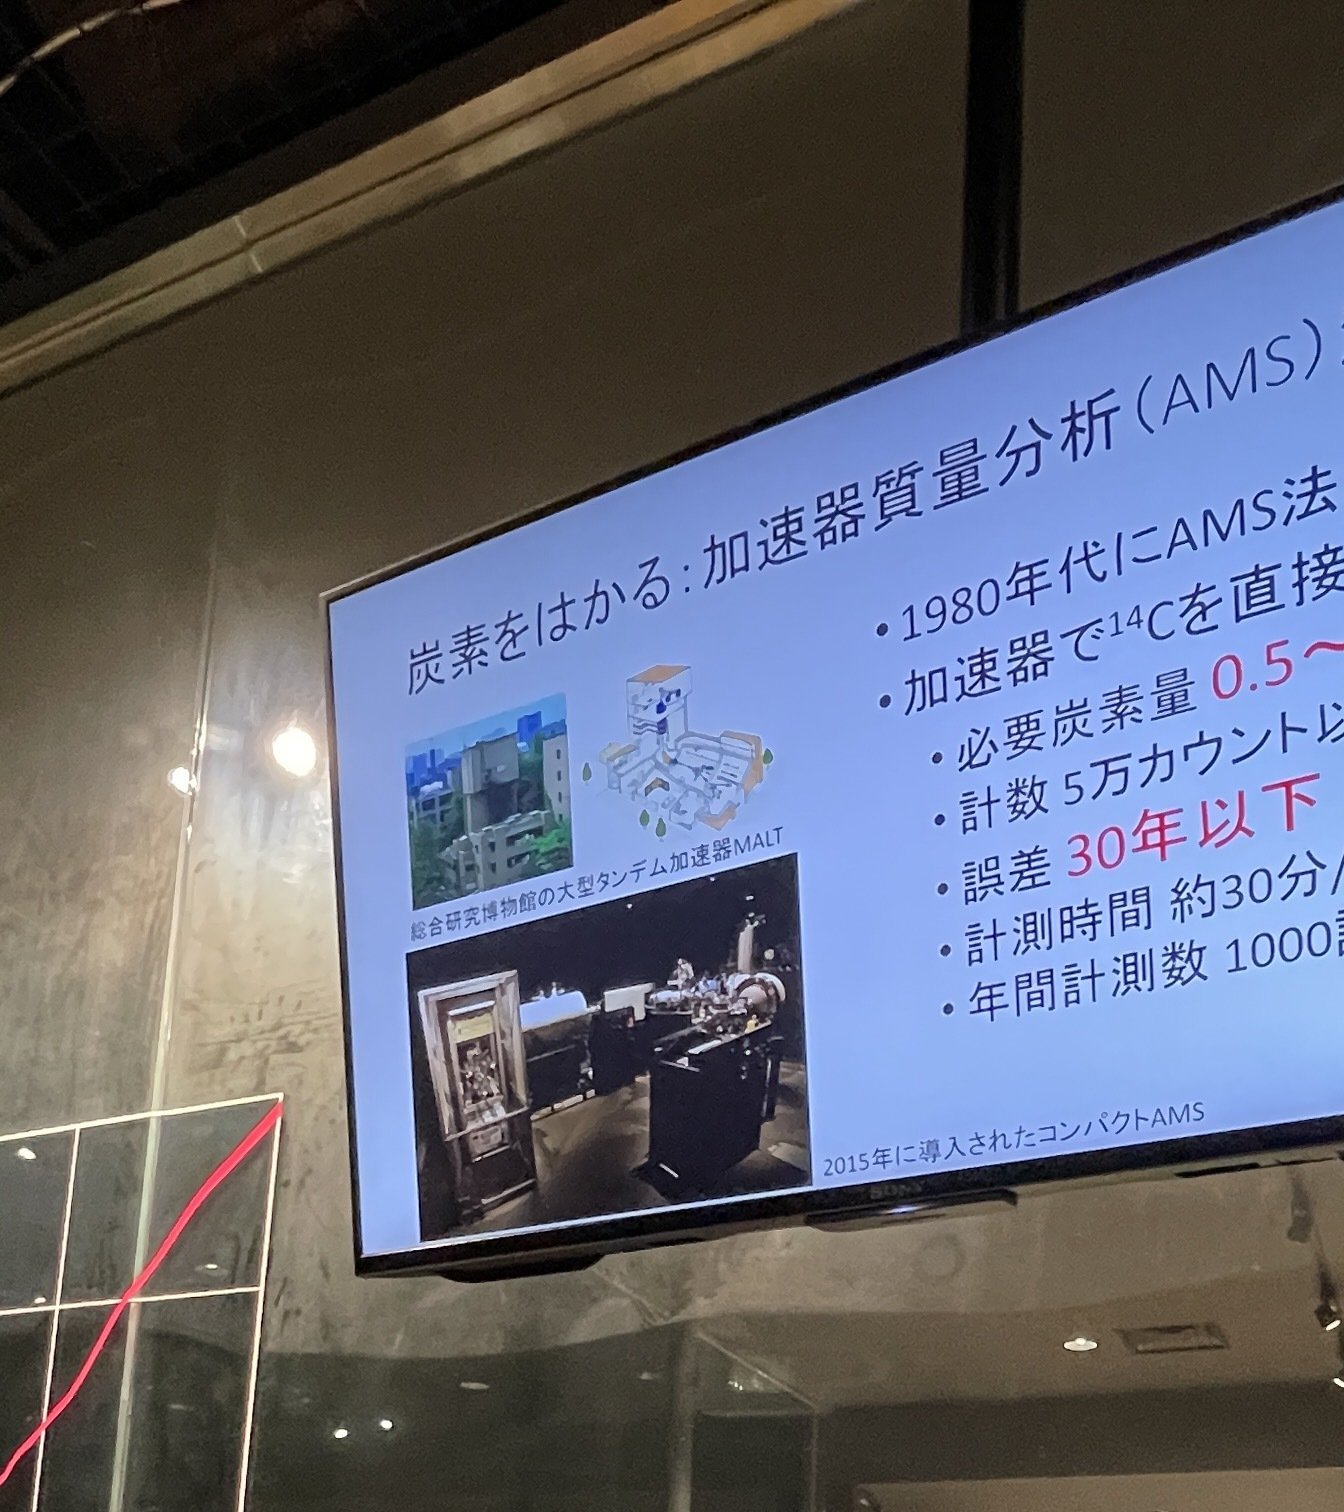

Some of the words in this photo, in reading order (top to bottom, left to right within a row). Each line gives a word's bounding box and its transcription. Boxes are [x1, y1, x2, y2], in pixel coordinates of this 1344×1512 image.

[957, 666, 1197, 773] 必要炭素量
[959, 774, 1050, 835] 計数
[963, 845, 1052, 905] 誤差
[1067, 772, 1322, 879] 30年以下
[411, 826, 784, 942] 総合研究博物館の大型タンデム加速器MALT
[965, 886, 1153, 967] 計測時間
[968, 939, 1208, 1023] 年間計測数
[823, 1102, 1206, 1177] 2015年に導入されたコンパクトAMS
